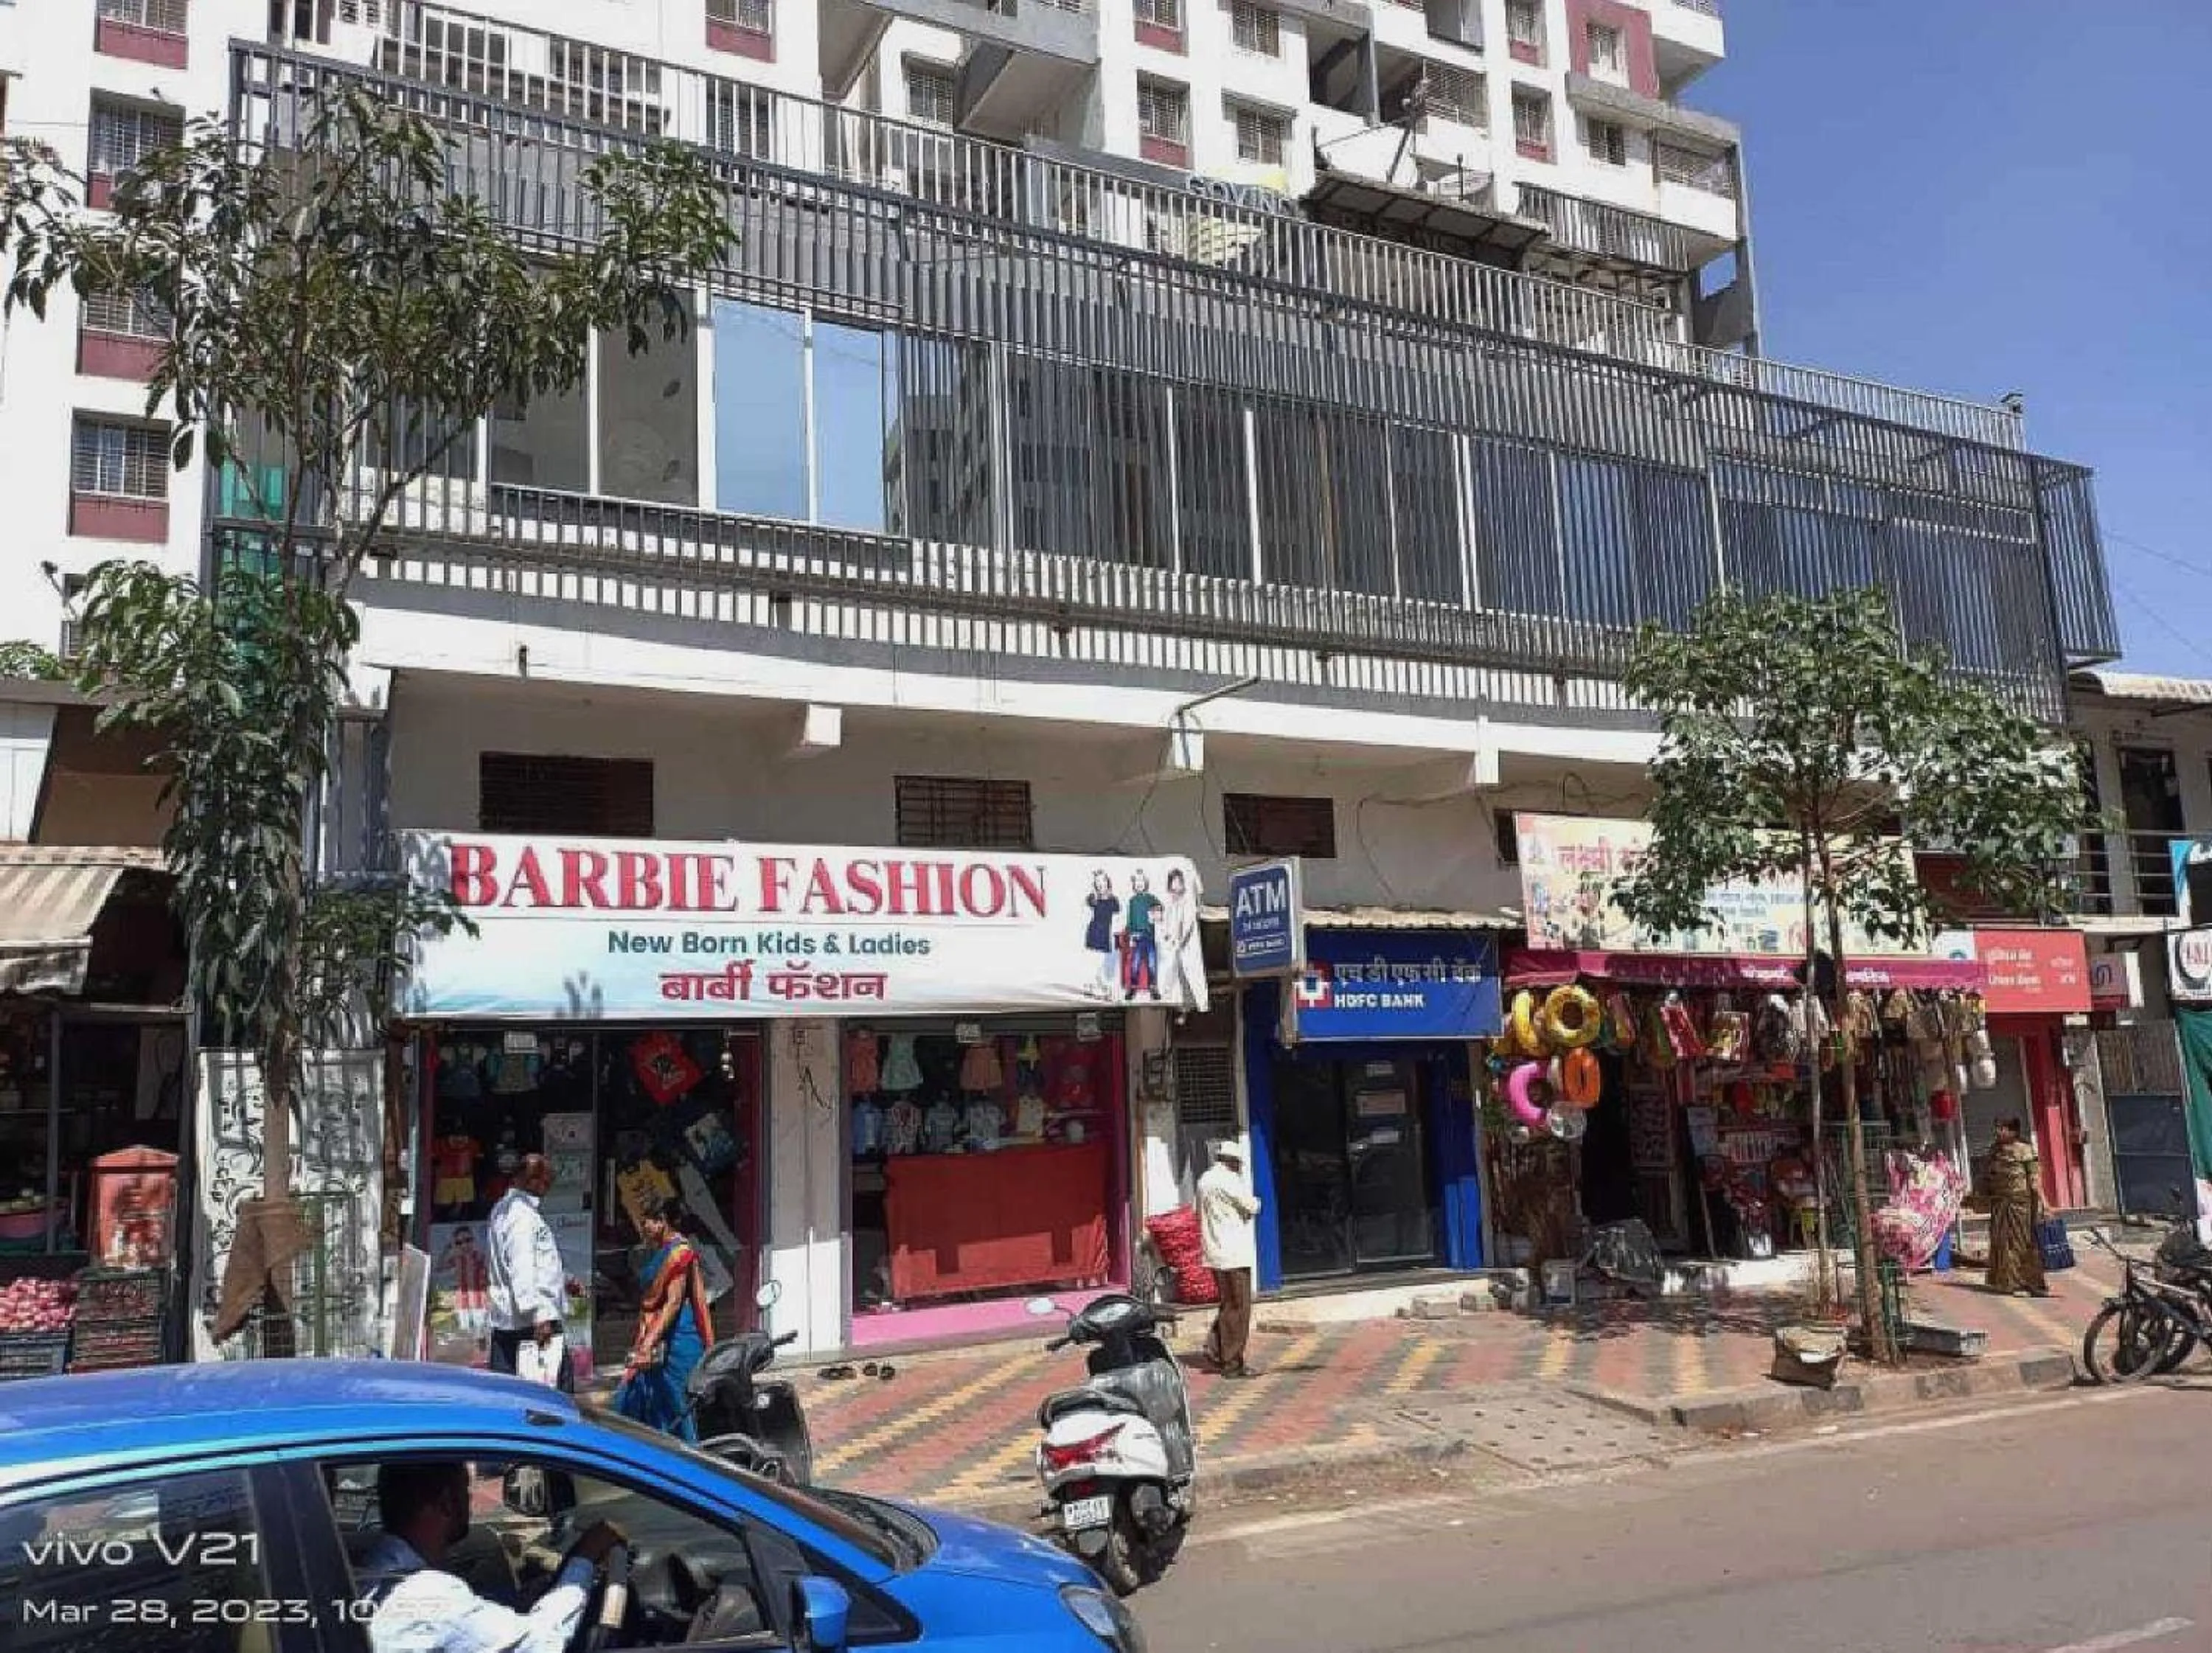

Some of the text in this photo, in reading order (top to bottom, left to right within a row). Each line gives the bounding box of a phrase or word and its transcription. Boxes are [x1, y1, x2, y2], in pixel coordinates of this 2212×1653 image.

[450, 842, 1047, 919] BARBIE FASHION
[1236, 877, 1287, 919] ATM
[608, 930, 931, 956] New Born Kids & Ladies
[658, 958, 888, 1001] बार्बी फॅशन
[1335, 993, 1425, 1009] HDFC BANK
